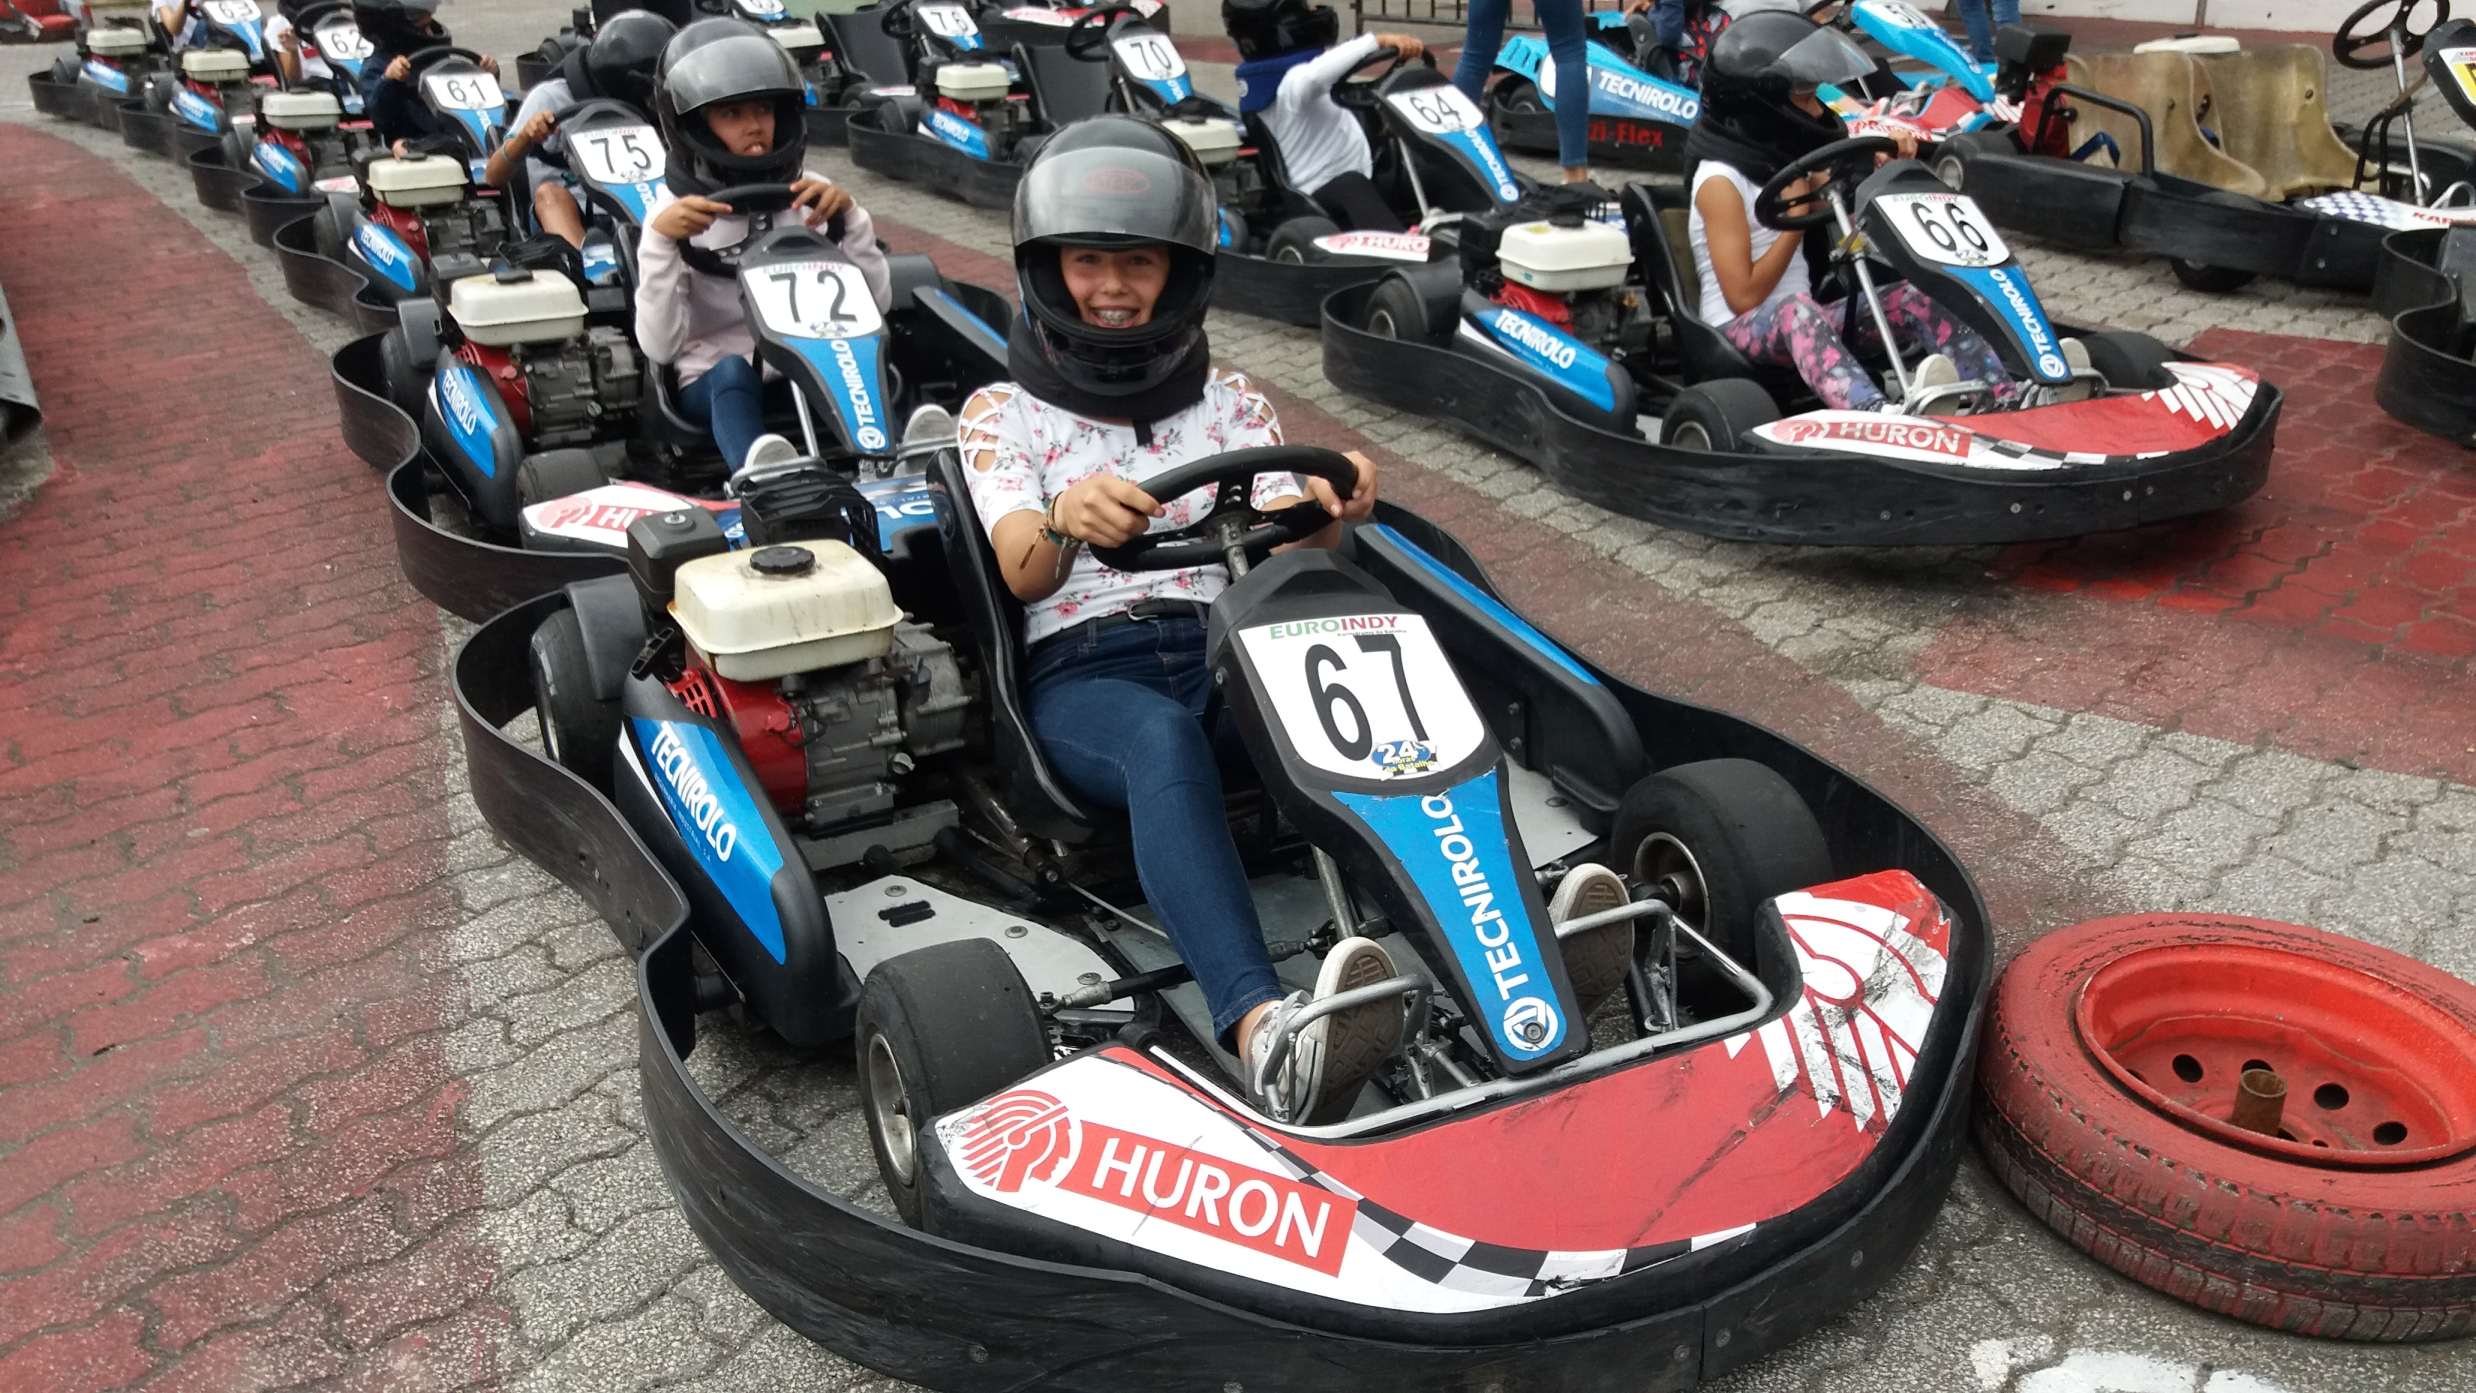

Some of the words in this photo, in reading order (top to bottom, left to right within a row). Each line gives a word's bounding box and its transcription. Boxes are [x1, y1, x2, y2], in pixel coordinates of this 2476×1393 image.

[331, 29, 367, 53] 62
[1130, 41, 1172, 71] 70
[447, 80, 486, 102] 61
[1409, 92, 1462, 125] 64
[1599, 71, 1699, 120] TECNIROLO
[590, 134, 652, 174] 75
[1369, 236, 1430, 252] HURO
[1911, 203, 1988, 251] 66
[769, 270, 858, 323] 72
[1990, 269, 2053, 355] TECNIROLO
[1494, 308, 1576, 369] TECNIROLO
[831, 340, 875, 426] TECNIROLO
[1840, 422, 1960, 454] HURON
[1269, 615, 1398, 641] EUROINDY
[1305, 634, 1430, 761] 67
[1378, 740, 1418, 765] 24
[651, 720, 737, 862] TECNIROLO
[1421, 791, 1529, 1000] TECNIROLO
[1092, 1137, 1331, 1258] HURON
